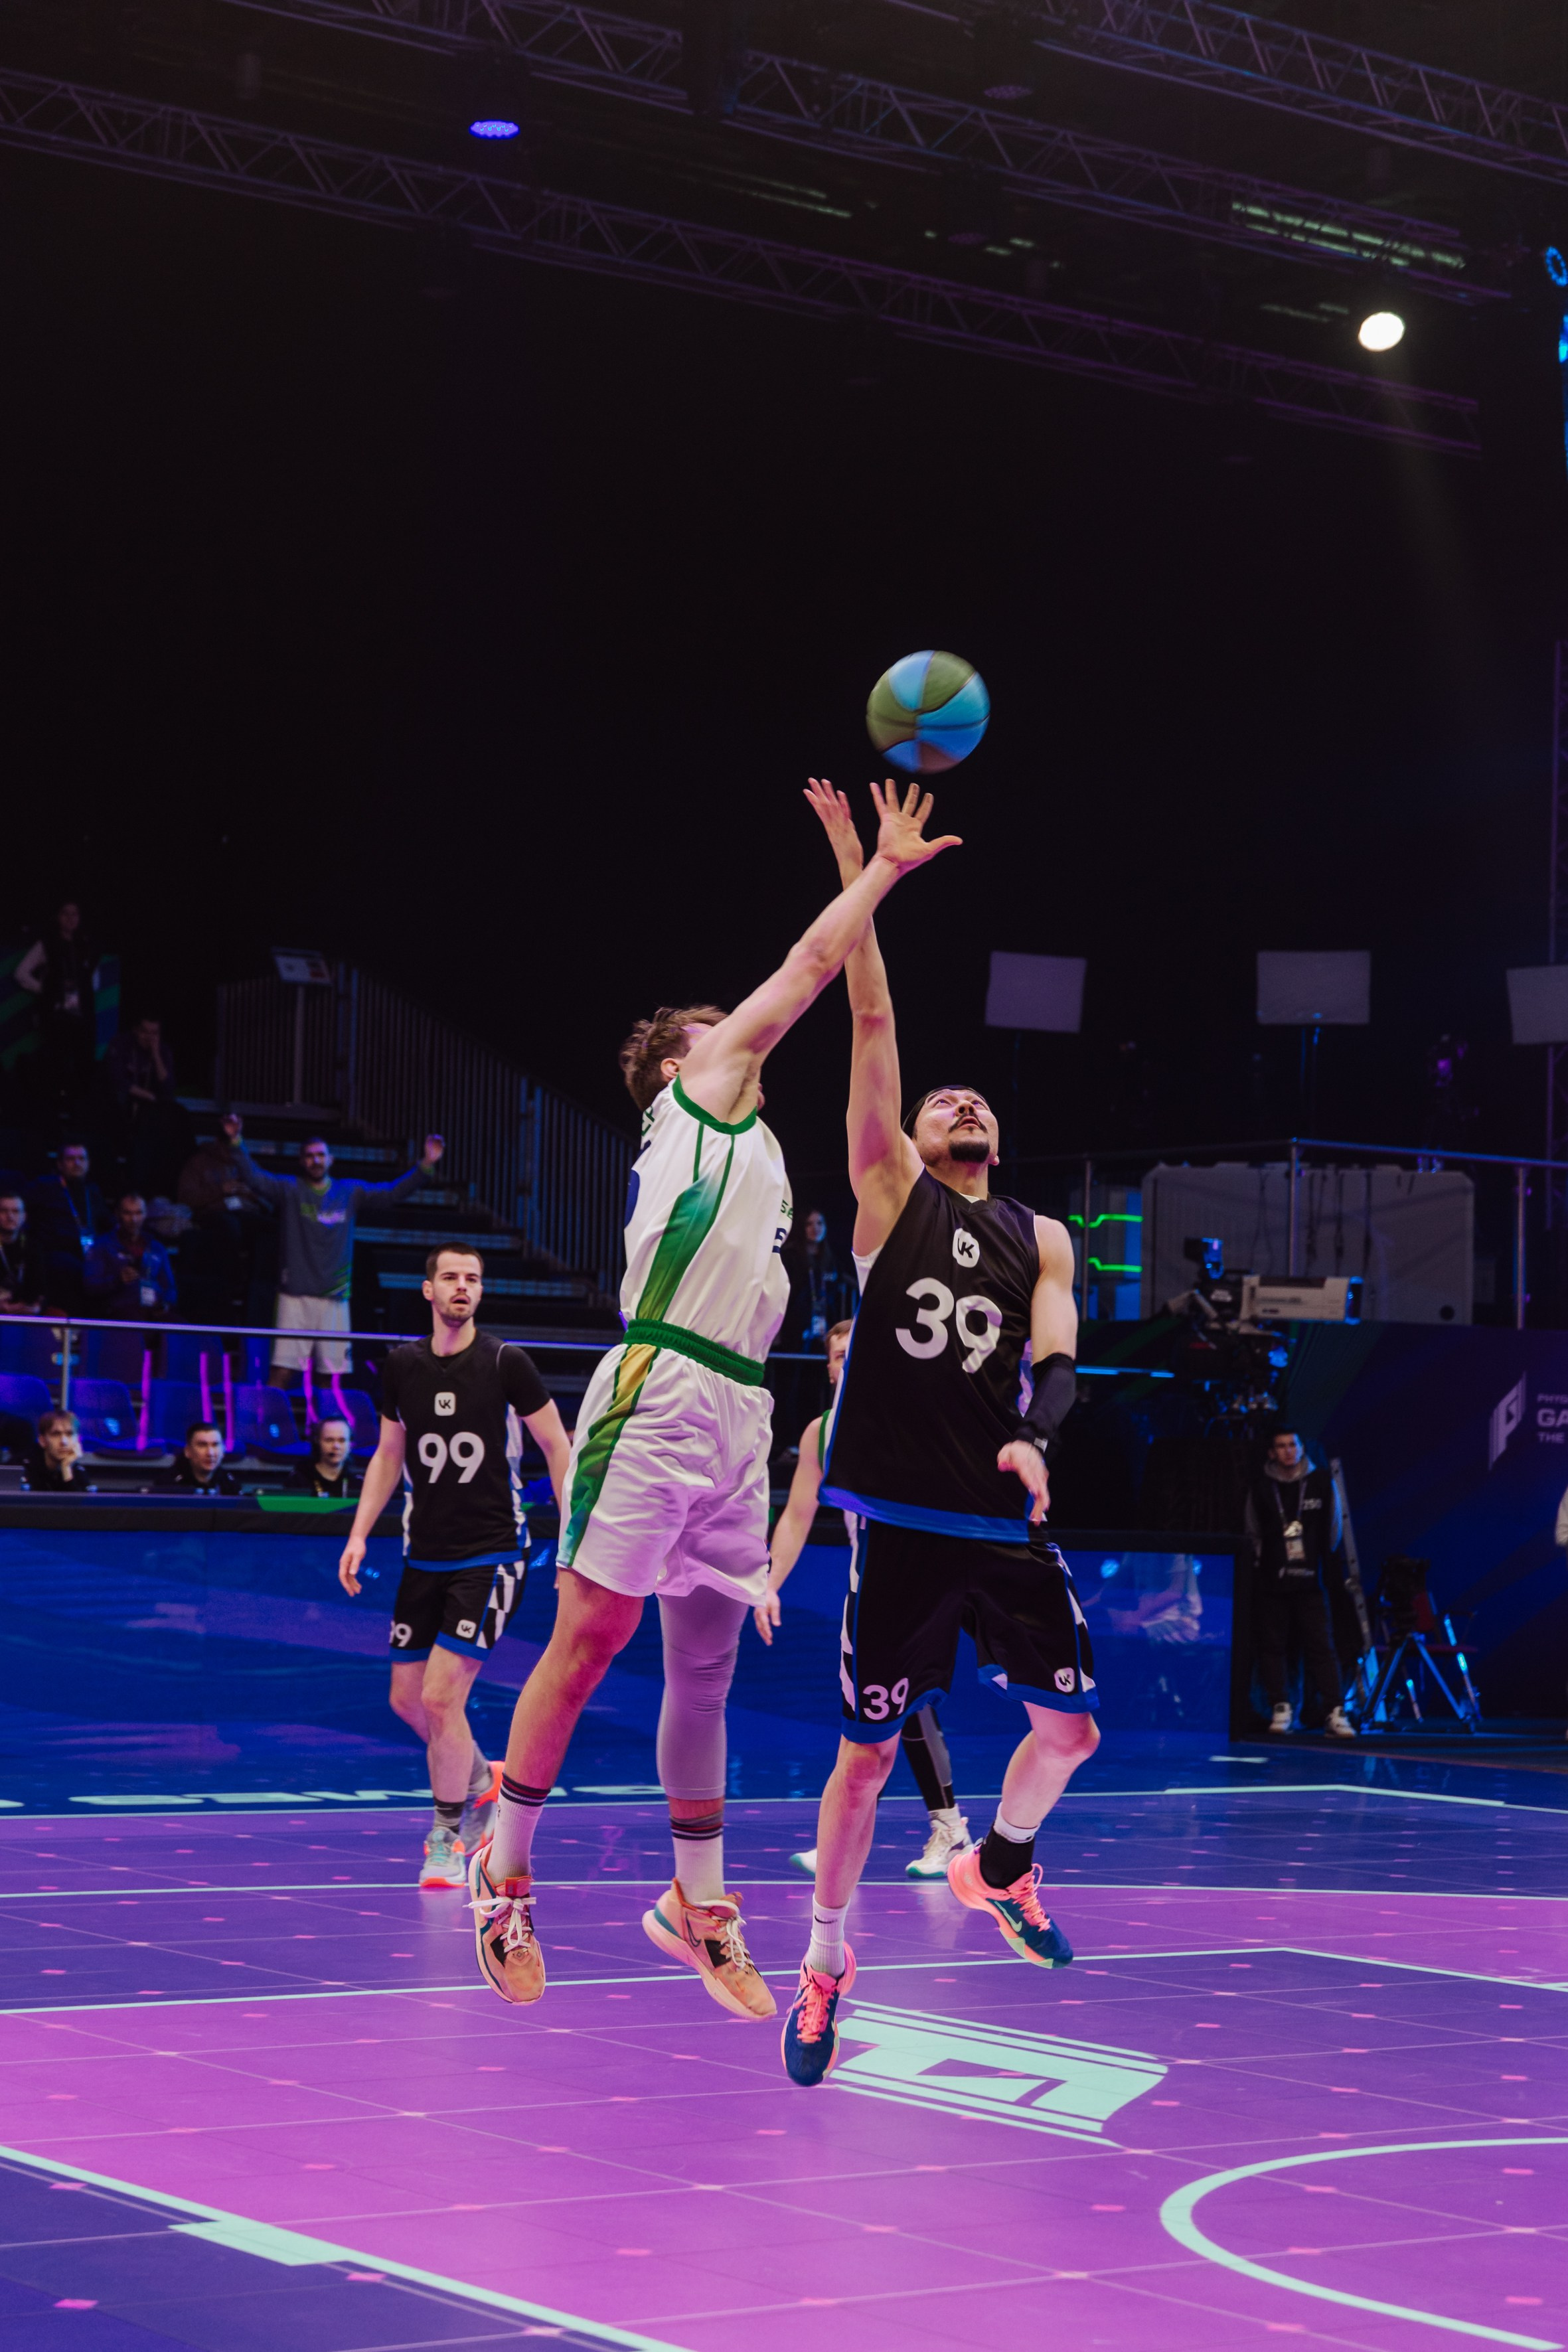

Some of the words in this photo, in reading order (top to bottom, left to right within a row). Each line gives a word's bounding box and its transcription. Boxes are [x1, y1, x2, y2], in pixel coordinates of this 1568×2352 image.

[895, 1277, 1003, 1374] 39
[417, 1431, 486, 1484] 99
[1537, 1431, 1565, 1444] THE
[862, 1677, 909, 1721] 39
